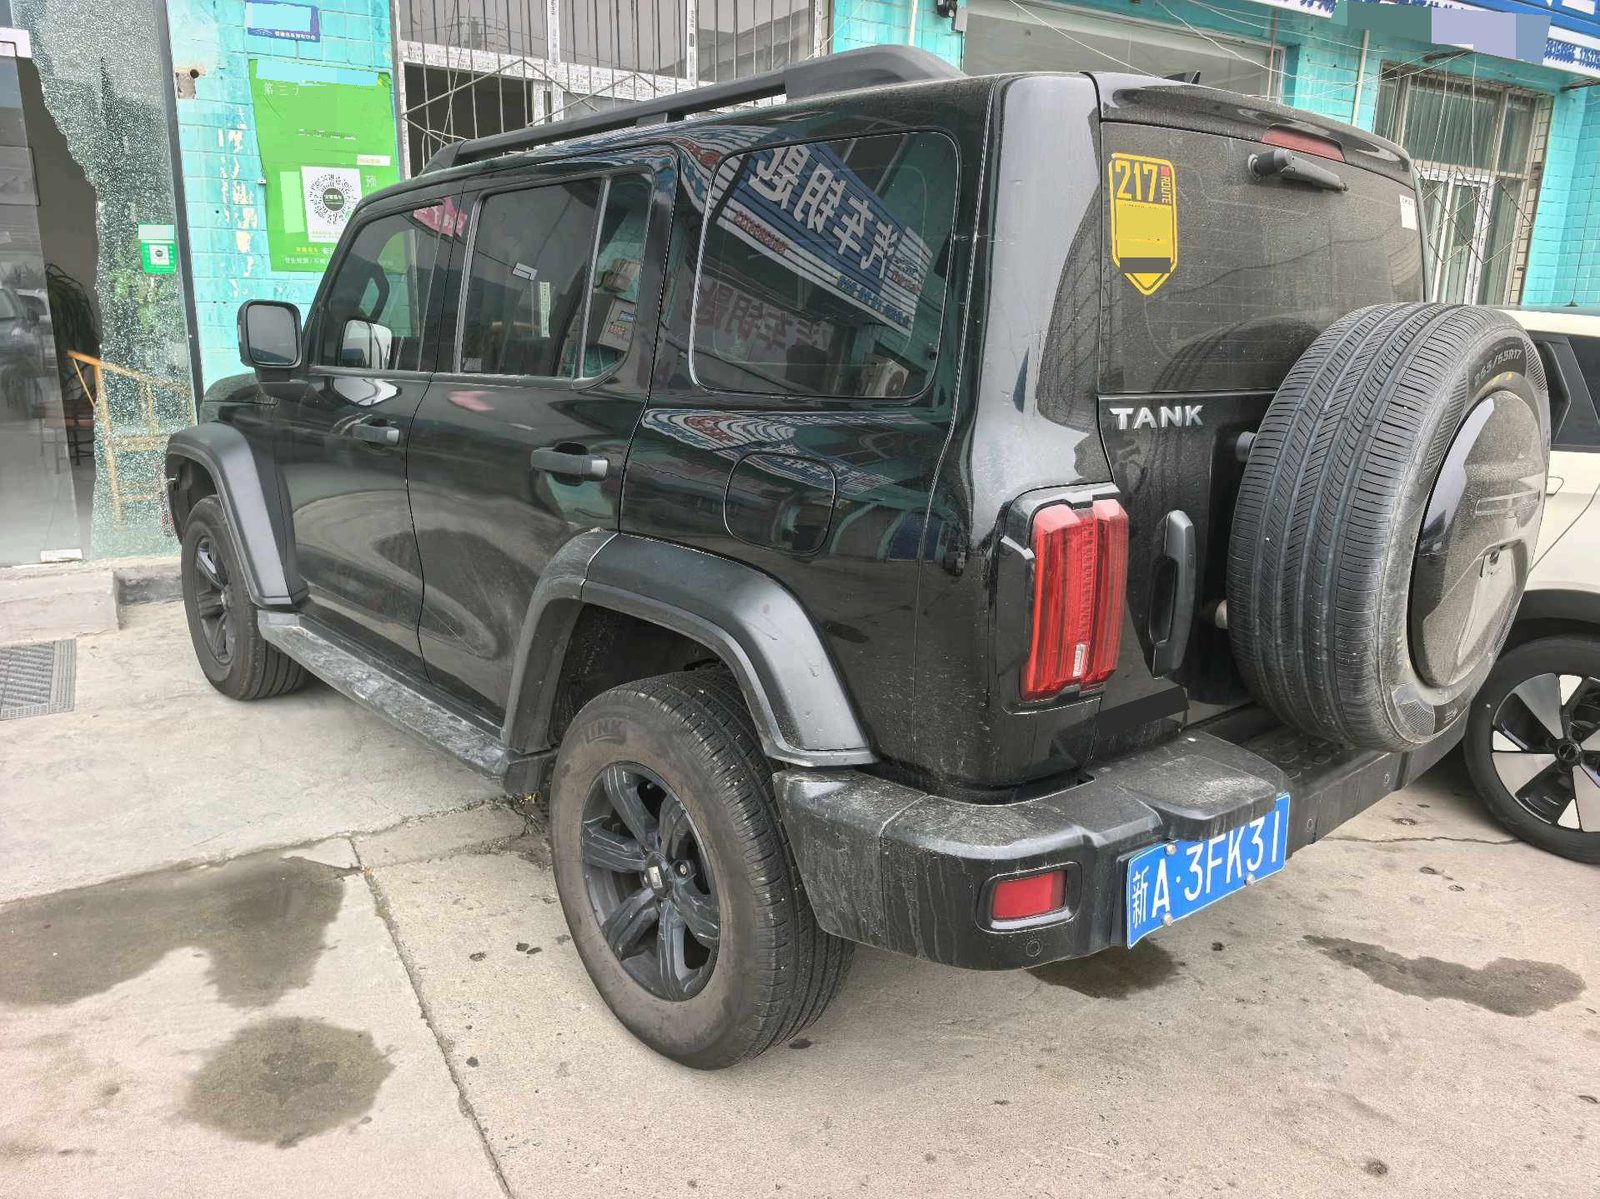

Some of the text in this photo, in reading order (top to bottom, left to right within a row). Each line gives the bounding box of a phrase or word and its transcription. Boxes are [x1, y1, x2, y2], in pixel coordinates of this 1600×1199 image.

[1115, 160, 1158, 202] 217
[1161, 176, 1172, 205] ROUTE
[1109, 405, 1203, 430] TANK
